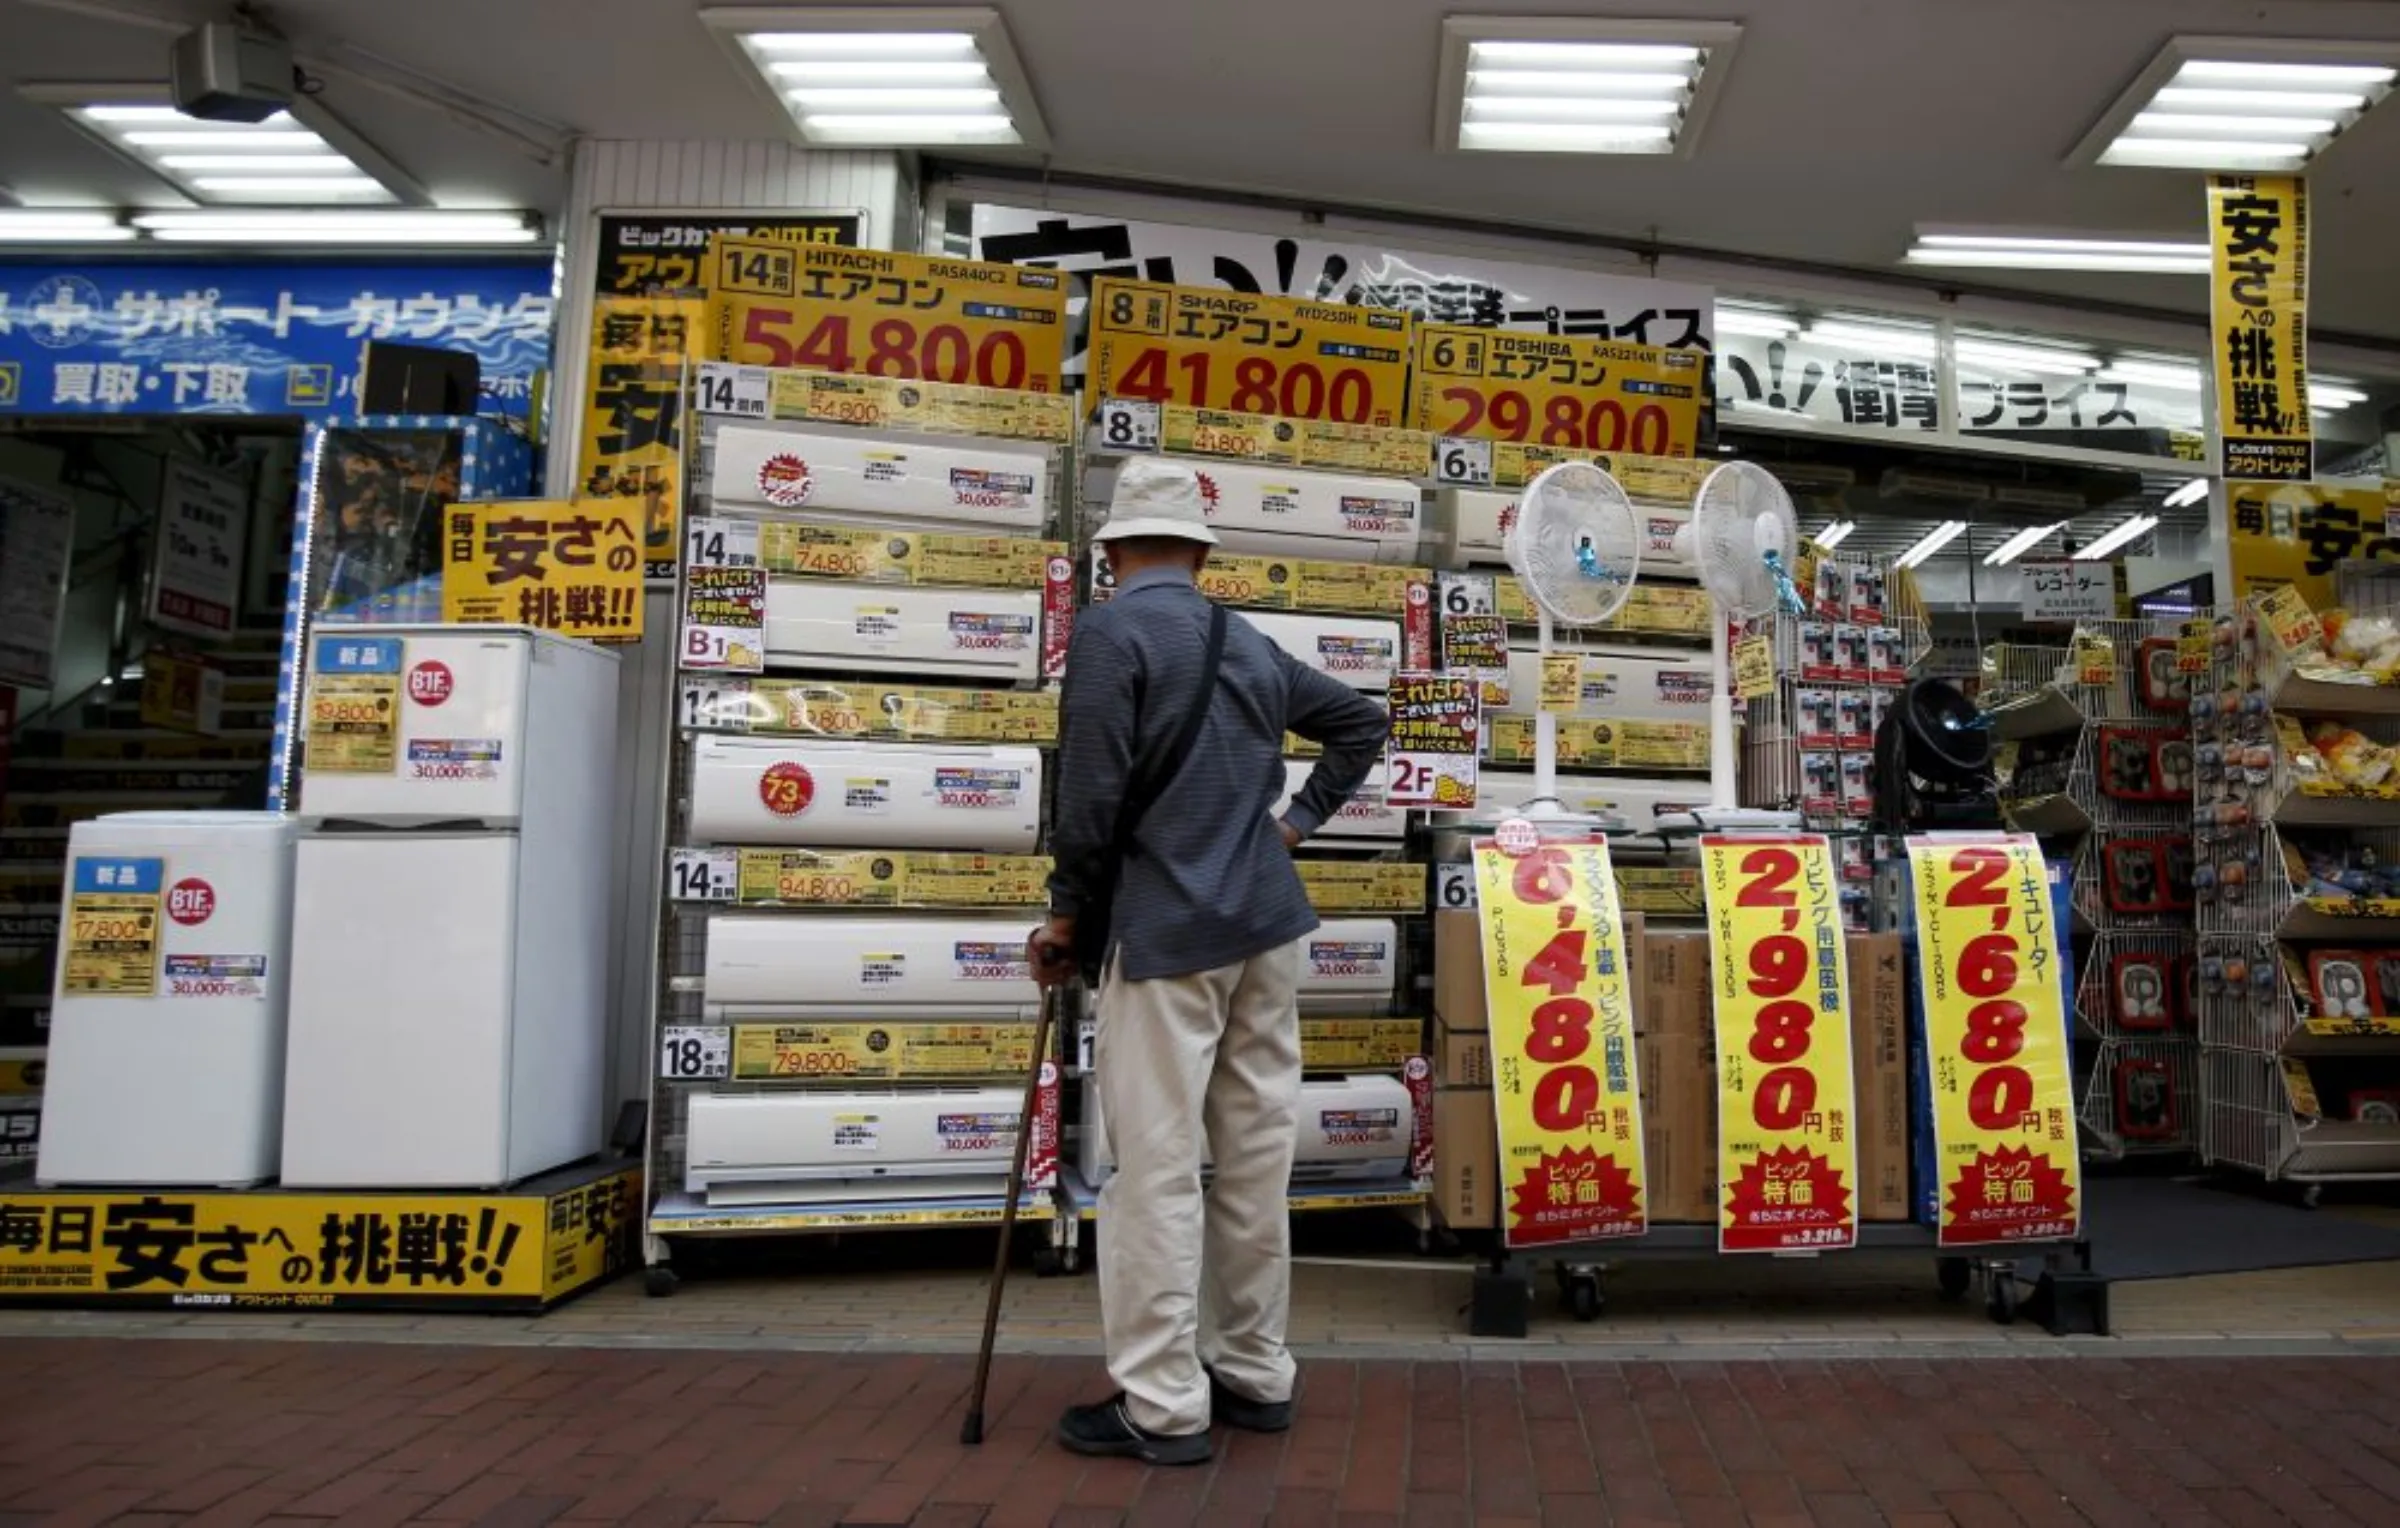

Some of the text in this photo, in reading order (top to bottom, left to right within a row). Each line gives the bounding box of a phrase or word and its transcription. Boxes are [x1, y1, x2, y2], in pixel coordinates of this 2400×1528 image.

[726, 252, 771, 286] 14
[805, 249, 894, 273] HITACHI
[928, 263, 1007, 285] RASA40C2
[802, 269, 945, 310] エアコン
[1179, 293, 1258, 314] SHARP
[1110, 292, 1135, 325] 8
[1175, 311, 1304, 348] エアコン
[743, 307, 1026, 388] 54800
[1433, 338, 1455, 368] 6
[1492, 336, 1573, 358] TOSHIBA
[53, 362, 249, 404] 買取・下取
[1490, 351, 1607, 387] エアコン
[700, 375, 736, 411] 14
[1115, 347, 1374, 425] 41800
[1109, 411, 1134, 443] 8
[1442, 387, 1671, 457] 29800
[1444, 449, 1467, 477] 6
[690, 531, 726, 566] 14
[1447, 585, 1468, 614] 6
[764, 774, 799, 803] 73
[1391, 759, 1433, 793] 2F
[674, 861, 710, 898] 14
[1444, 874, 1467, 905] 6
[666, 1038, 702, 1075] 18
[1549, 1161, 1597, 1182] ビック
[1764, 1162, 1811, 1179] ビック
[1984, 1160, 2031, 1179] ビック
[1547, 1180, 1601, 1206] 特価
[1762, 1178, 1814, 1206] 特価
[1982, 1178, 2035, 1205] 特価
